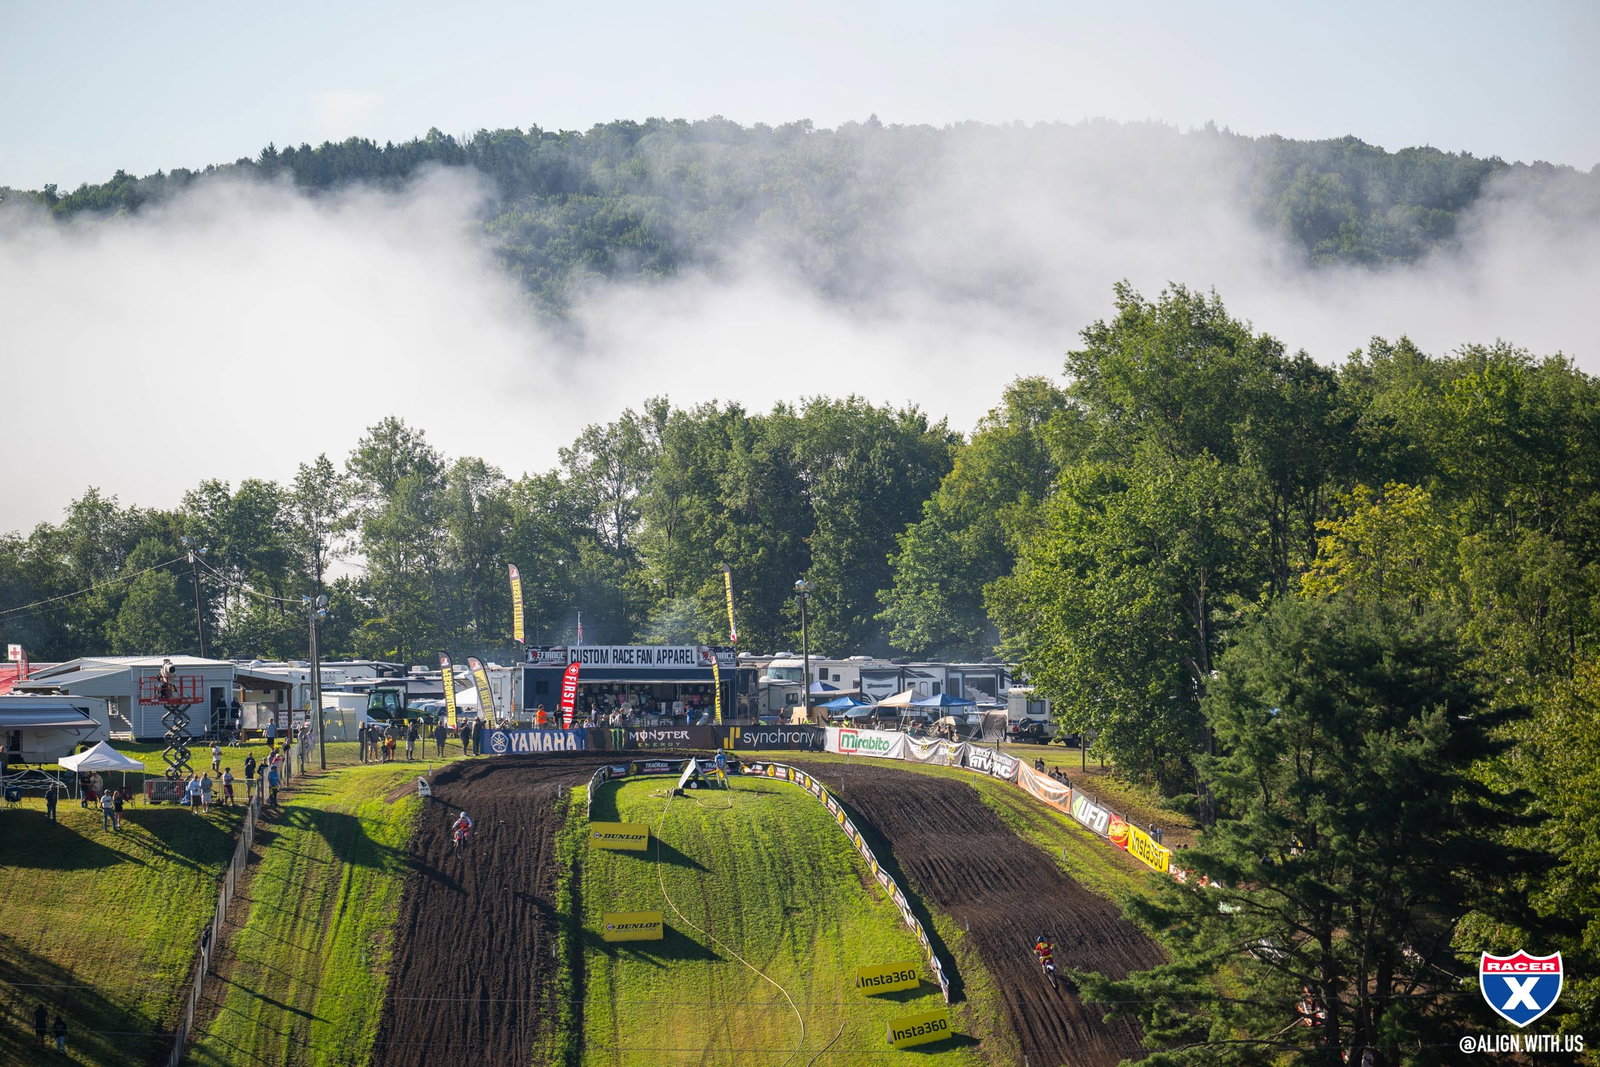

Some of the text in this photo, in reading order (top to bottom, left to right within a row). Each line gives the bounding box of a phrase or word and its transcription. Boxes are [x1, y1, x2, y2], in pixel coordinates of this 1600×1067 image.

[570, 649, 695, 664] CUSTOM RACE FAN APPAREL
[563, 675, 577, 704] FIRST
[510, 732, 577, 752] YAMAHA
[629, 730, 690, 741] MONSTER
[743, 729, 815, 747] synchrony
[1077, 799, 1108, 832] UFO
[616, 922, 660, 930] DUNLOP
[861, 969, 916, 988] Insta360
[893, 1019, 947, 1041] Insta360
